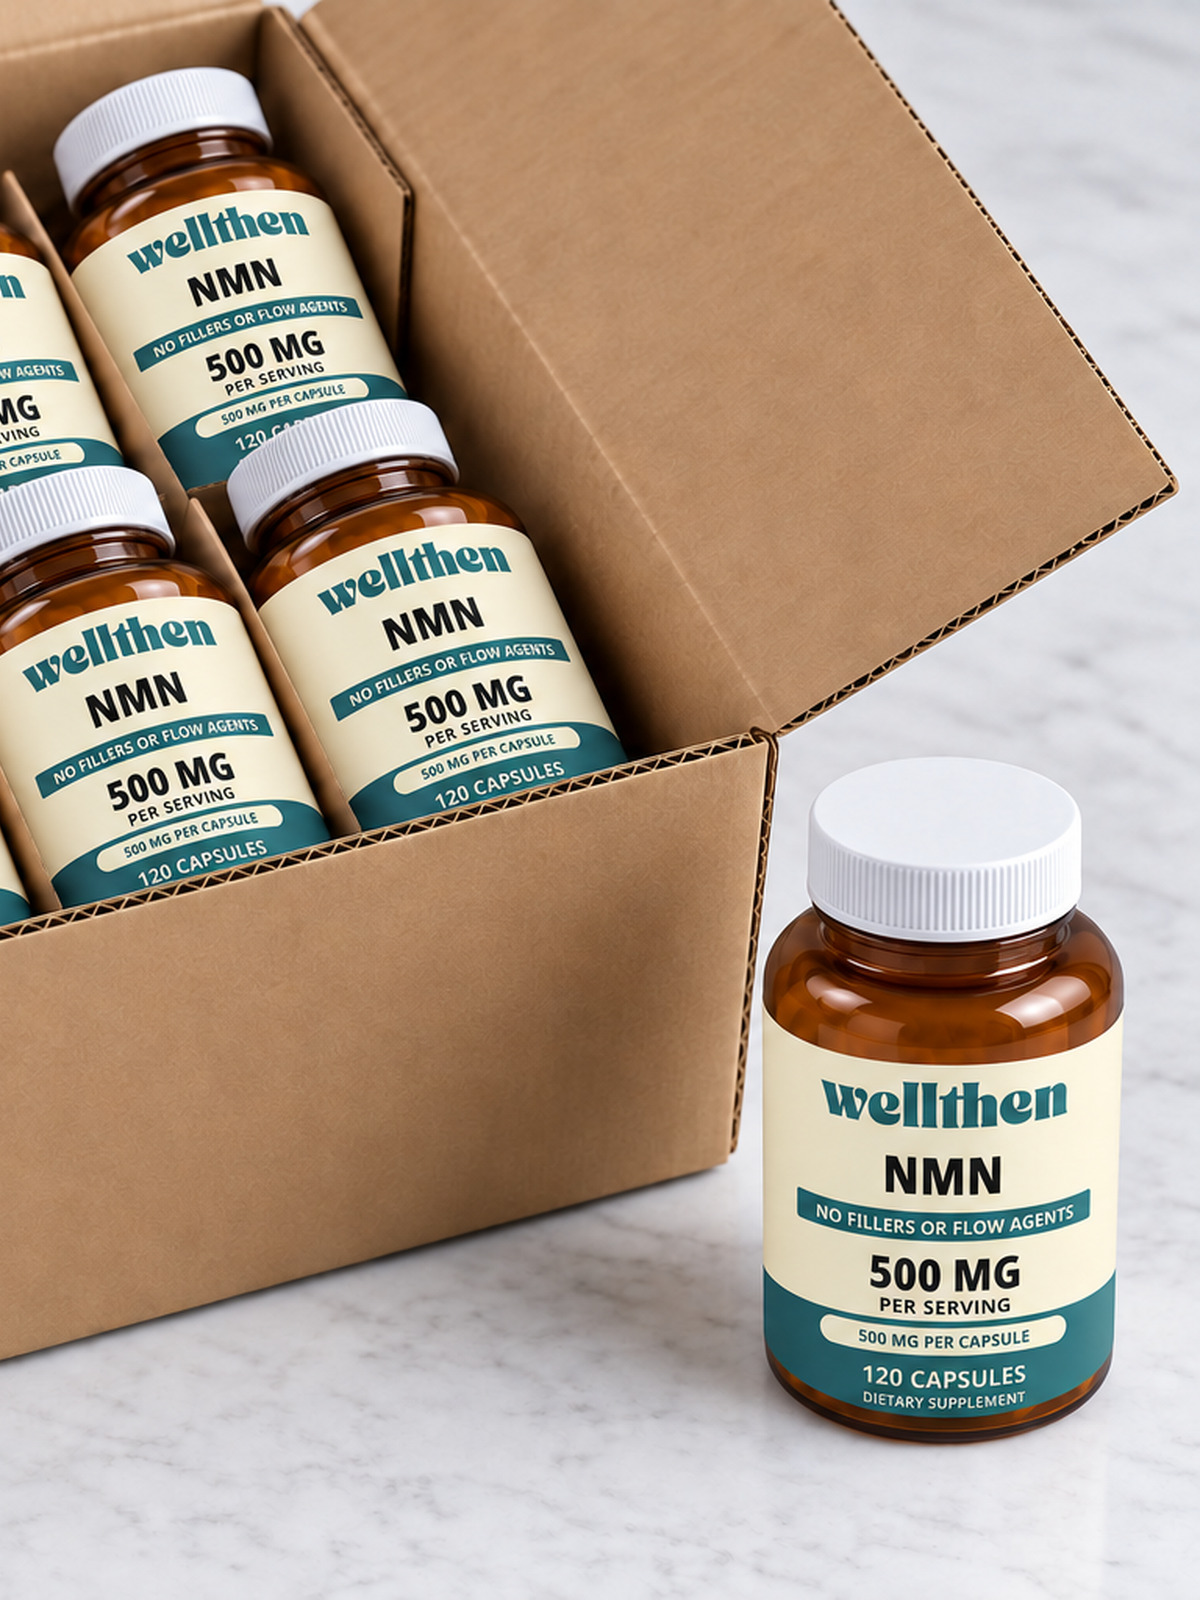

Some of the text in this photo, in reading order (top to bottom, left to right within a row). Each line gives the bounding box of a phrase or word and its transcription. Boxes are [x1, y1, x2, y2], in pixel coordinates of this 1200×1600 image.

[127, 207, 309, 274] wellthen
[188, 258, 282, 307] NMN
[154, 301, 347, 357] NO FILLERS OR FLOW AGENTS
[17, 365, 64, 376] AGENTS
[206, 331, 325, 382] 500 MG
[225, 362, 324, 396] PER SERVING
[318, 542, 511, 615] wellthen
[382, 597, 484, 650] NMN
[22, 616, 216, 692] wellthen
[350, 644, 554, 706] NO FILLERS OR FLOW AGENTS
[86, 672, 187, 728] NMN
[404, 676, 532, 733] 500 MG
[54, 719, 258, 784] NO FILLERS OR FLOW AGENTS
[425, 709, 532, 748] PER SERVING
[422, 734, 555, 780] 500 MG PER CAPSULE
[107, 753, 234, 811] 500 MG
[435, 762, 564, 808] 120 CAPSULES
[128, 787, 234, 826] PER SERVING
[124, 812, 258, 858] 500 MG PER CAPSULE
[138, 840, 267, 886] 120 CAPSULES
[822, 1080, 1067, 1128] wellthen
[886, 1155, 1000, 1195] NMN
[817, 1204, 1073, 1235] NO FILLERS OR FLOW AGENTS
[869, 1255, 1019, 1292] 500 MG
[880, 1297, 1010, 1315] PER SERVING
[859, 1329, 1029, 1348] 500 MG PER CAPSULE
[864, 1365, 1026, 1388] 120 CAPSULES
[864, 1391, 1025, 1409] DIETARY SUPPLEMENT
